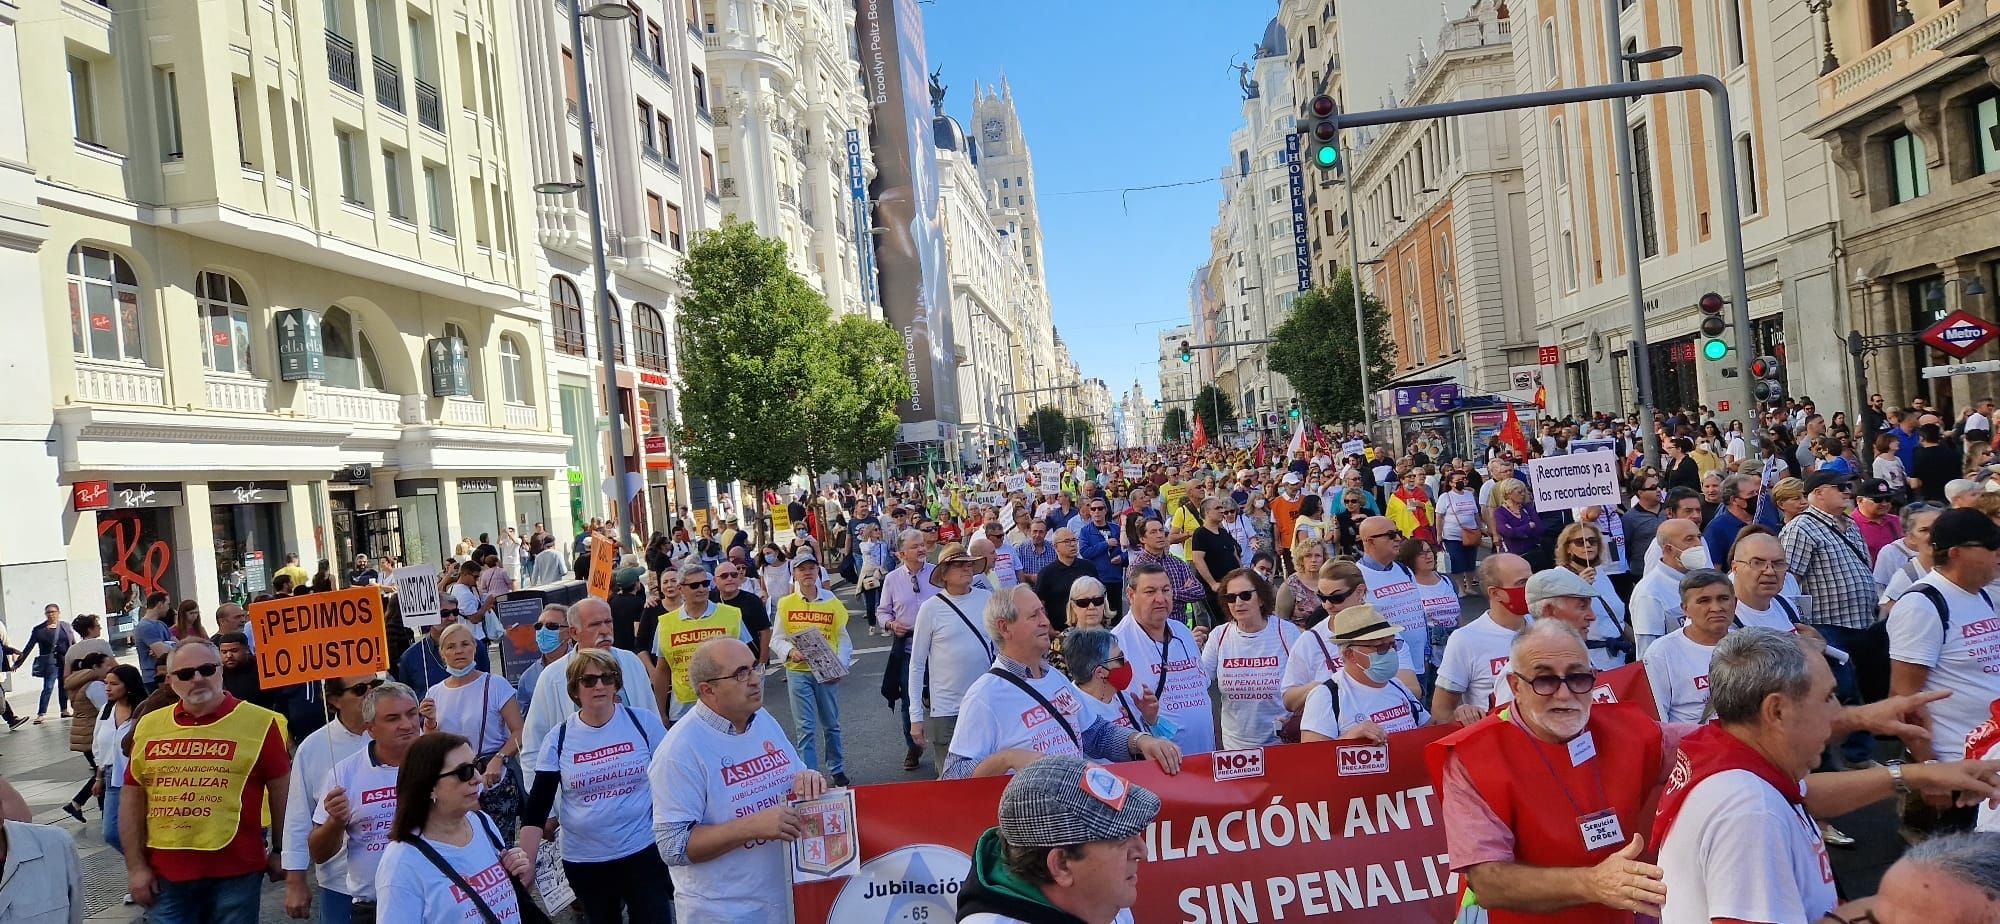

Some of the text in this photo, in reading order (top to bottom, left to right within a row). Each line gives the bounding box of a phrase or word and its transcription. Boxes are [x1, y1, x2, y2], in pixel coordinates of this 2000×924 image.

[869, 21, 881, 51] Peltz
[872, 52, 887, 104] Brooklyn
[847, 131, 862, 189] HOTEL
[1288, 153, 1310, 290] HOTEL REGENTE
[1946, 328, 1981, 340] Metro
[904, 325, 922, 412] pepejeans.com
[1947, 366, 1977, 374] Callao
[1536, 463, 1610, 483] ¡Recortemos ya a
[77, 486, 107, 503] Ray-Ban
[120, 484, 155, 507] Ray-Ban
[1540, 482, 1614, 502] los recortadores!
[260, 598, 373, 645] ¡PEDIMOS
[790, 612, 832, 623] ASJUBI40
[261, 636, 382, 680] LO JUSTO!
[1968, 647, 1988, 656] SIN
[1225, 657, 1277, 668] ASJUBI40
[148, 742, 230, 757] ASJUBI40
[578, 744, 631, 762] ASJUBI40
[1341, 750, 1384, 765] NO+
[1217, 754, 1260, 770] NO+
[1342, 763, 1384, 771] PRECARIEDAD
[570, 766, 645, 790] SIN PENALIZAR
[1218, 766, 1260, 776] PRECARIEDAD
[156, 777, 229, 788] PENALIZAR
[180, 792, 196, 802] 40
[584, 784, 637, 803] COTIZADOS
[736, 804, 755, 818] SIN
[1344, 785, 1434, 838] ANT
[1590, 830, 1618, 843] ORDEN
[1596, 826, 1606, 834] DE
[1178, 880, 1259, 924] SIN
[912, 906, 928, 921] 65
